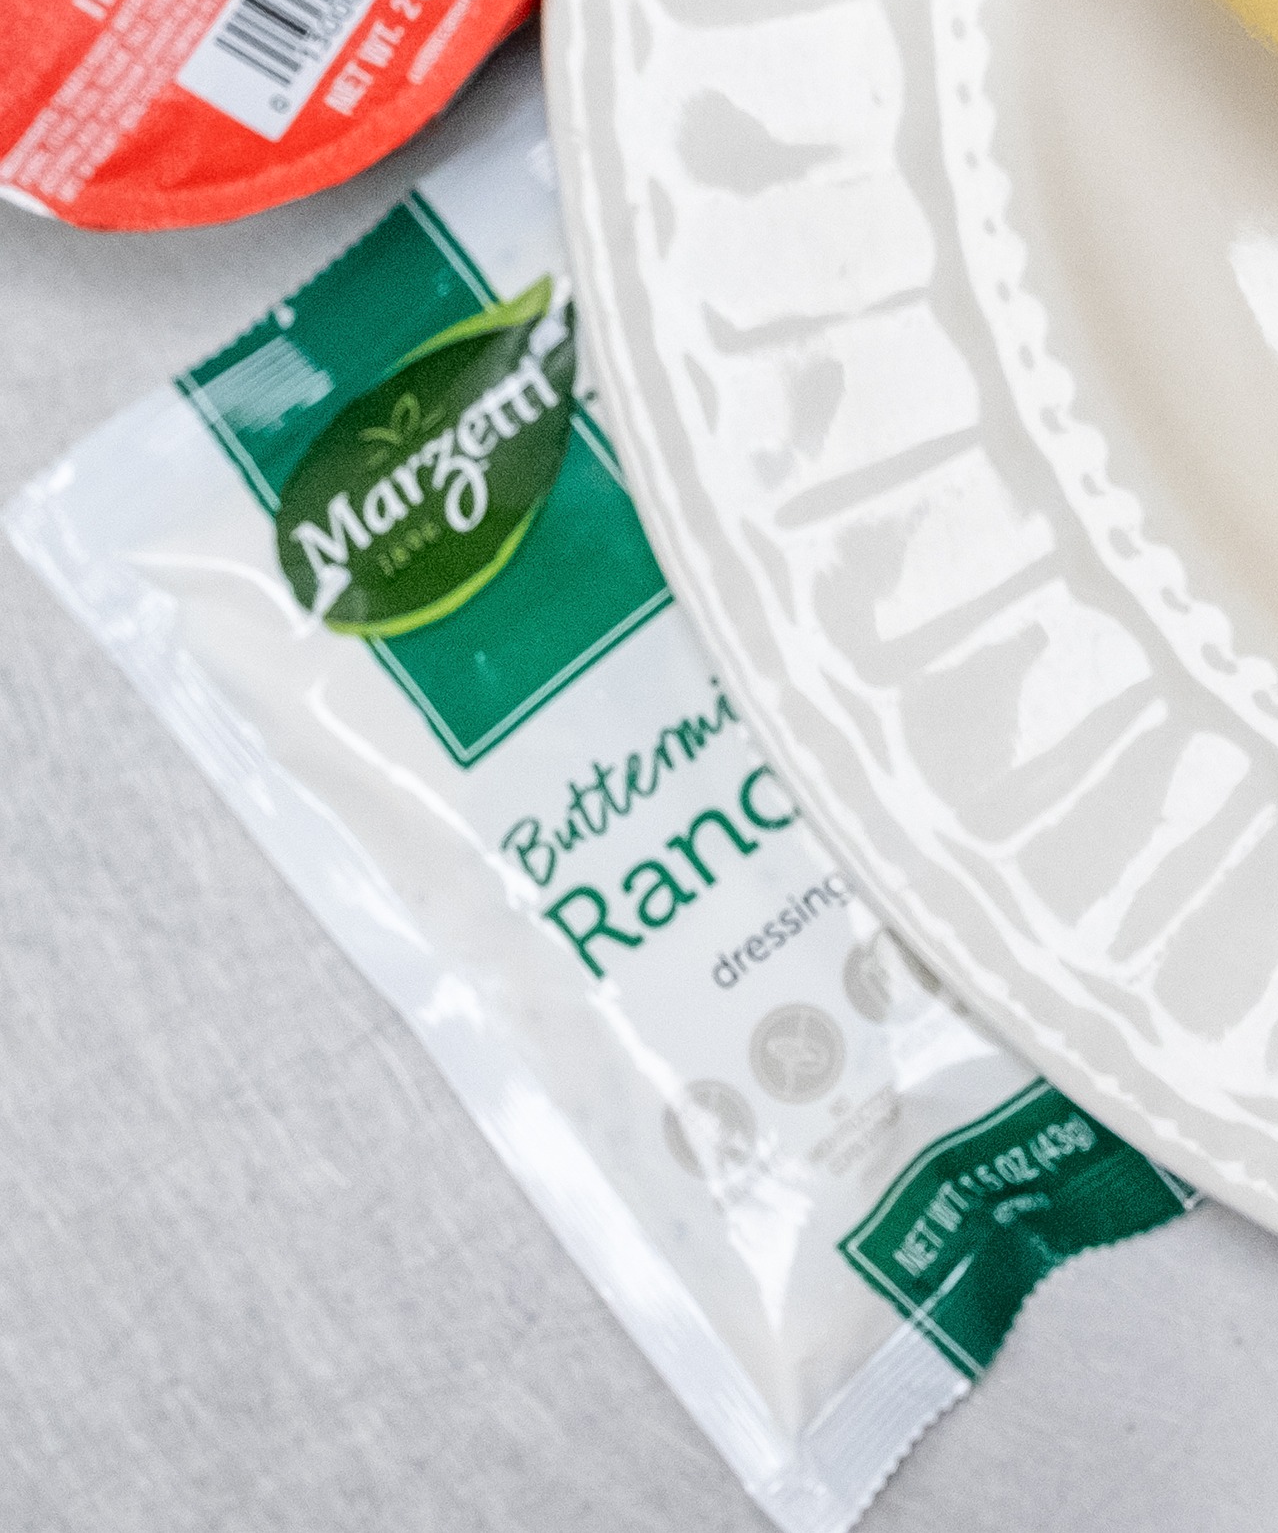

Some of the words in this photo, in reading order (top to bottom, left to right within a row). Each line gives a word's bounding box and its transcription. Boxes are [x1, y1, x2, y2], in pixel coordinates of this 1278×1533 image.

[323, 59, 375, 116] NET
[356, 18, 405, 67] WT.
[500, 675, 740, 887] Buttermi
[542, 761, 801, 979] Ranc
[712, 871, 852, 989] dressing
[892, 1217, 944, 1277] NET
[993, 1145, 1041, 1185] OZ
